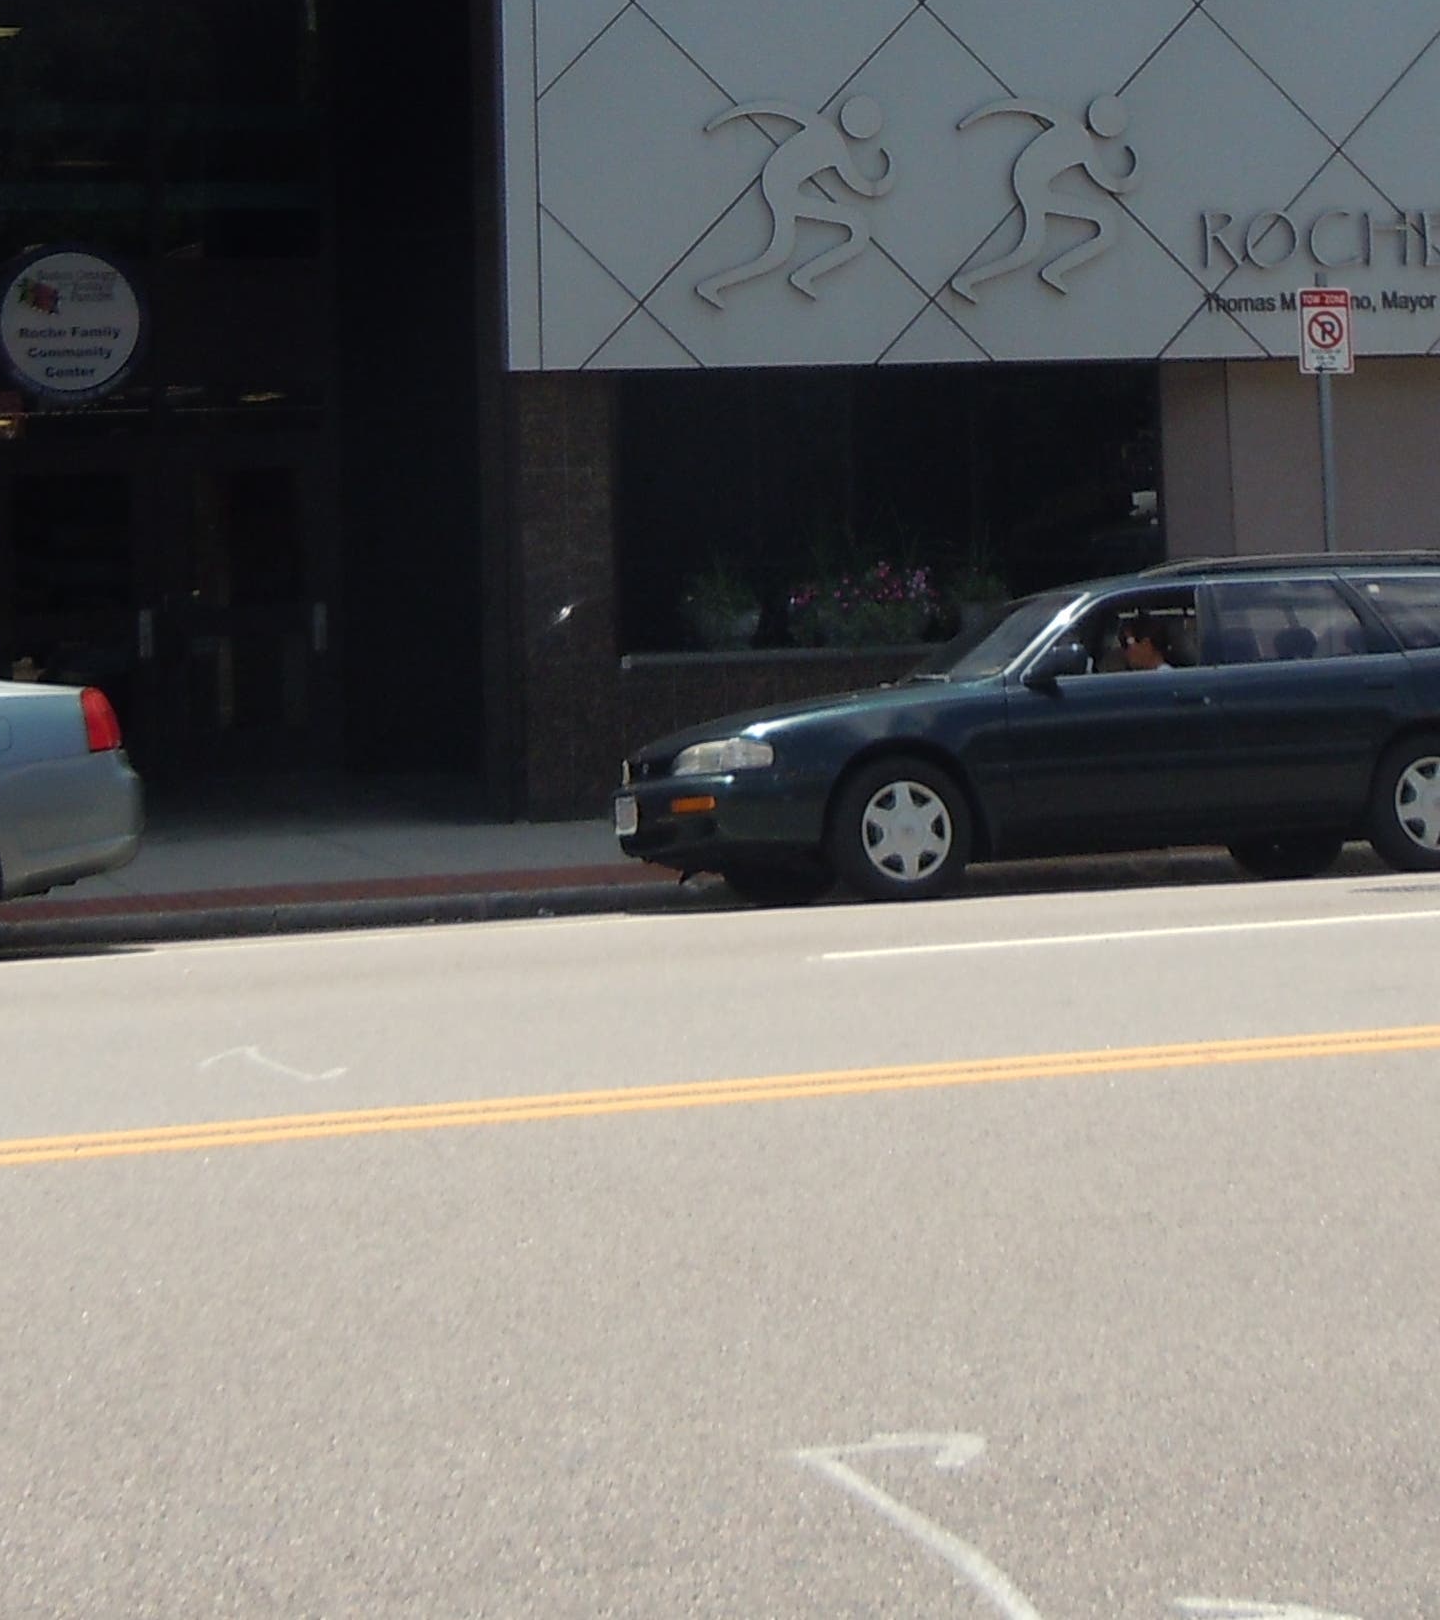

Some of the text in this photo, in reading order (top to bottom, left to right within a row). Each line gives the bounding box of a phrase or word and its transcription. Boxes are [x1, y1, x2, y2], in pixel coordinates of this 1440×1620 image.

[1205, 293, 1276, 312] Thomas
[1381, 290, 1437, 314] Mayor
[19, 326, 121, 339] Roche Family
[28, 347, 113, 359] Community
[46, 367, 95, 378] Center
